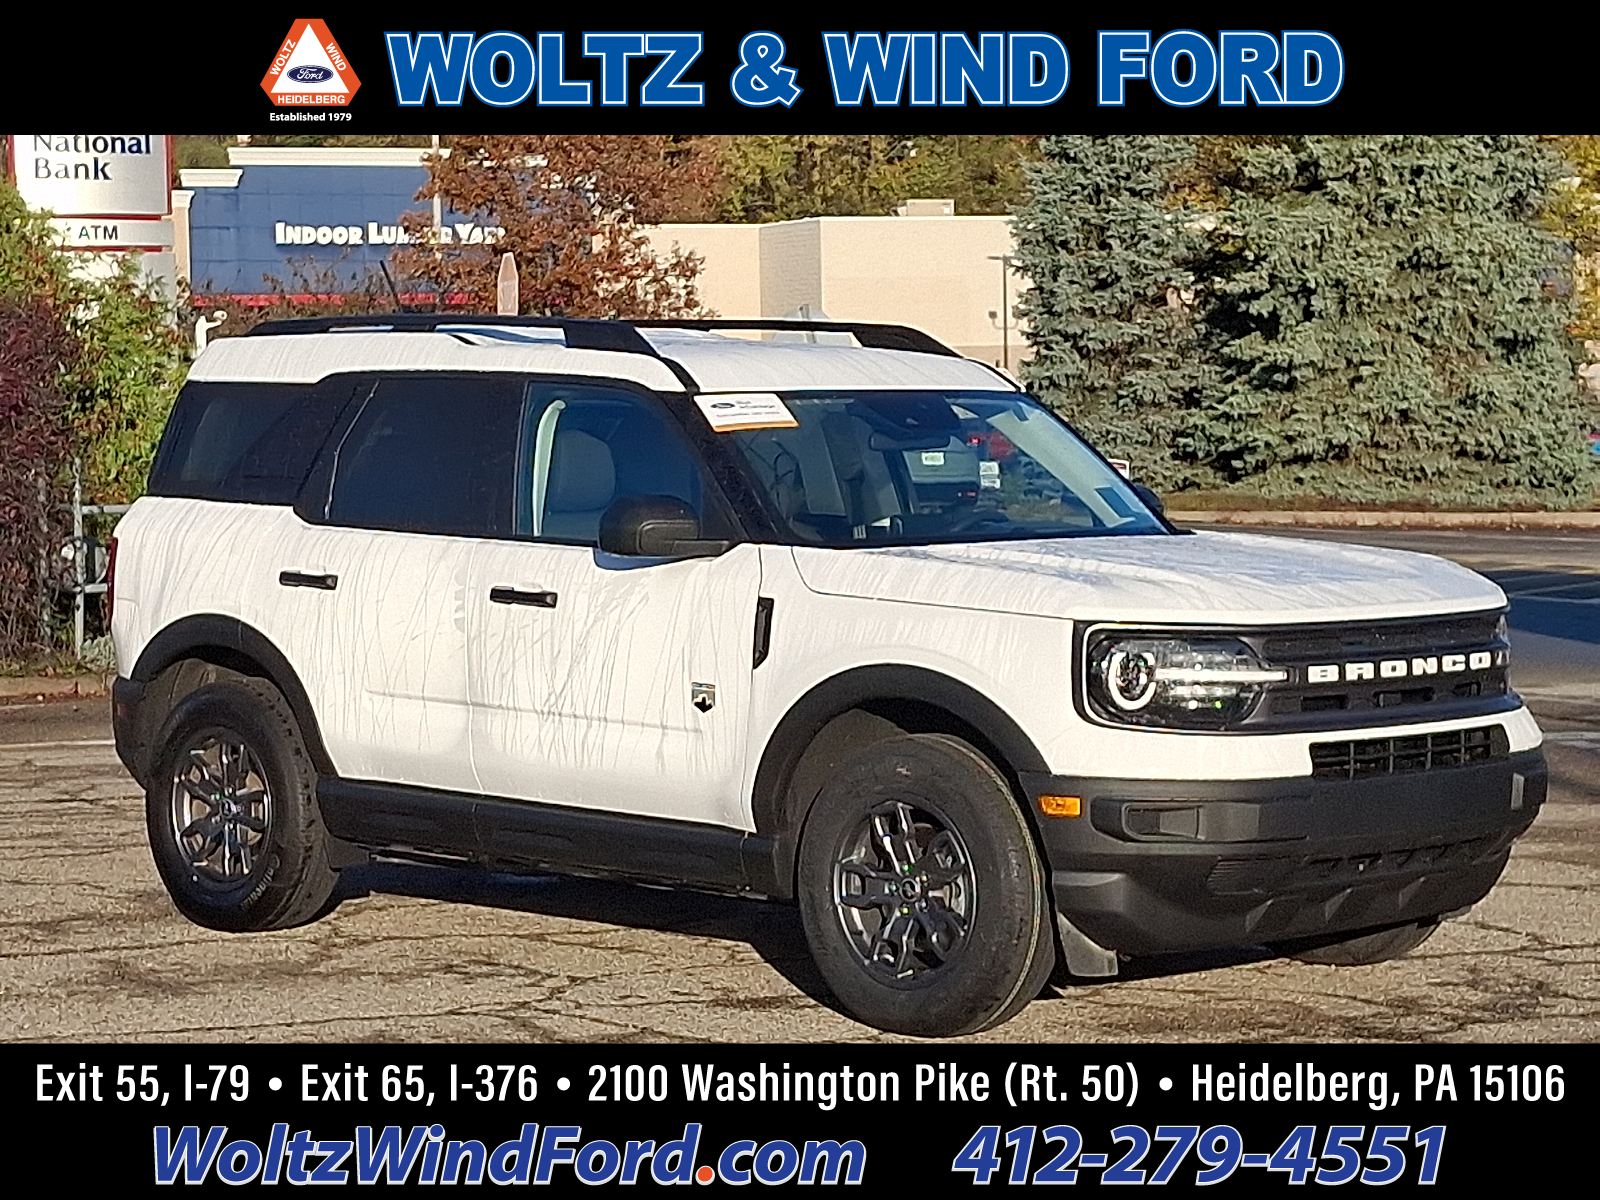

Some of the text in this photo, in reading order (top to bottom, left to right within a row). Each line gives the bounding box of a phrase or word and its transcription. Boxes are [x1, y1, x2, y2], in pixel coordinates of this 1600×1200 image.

[33, 134, 152, 155] National
[34, 156, 113, 181] Bank
[78, 225, 119, 241] ATM
[274, 222, 363, 245] INDOOR
[1307, 651, 1492, 684] BRONCO
